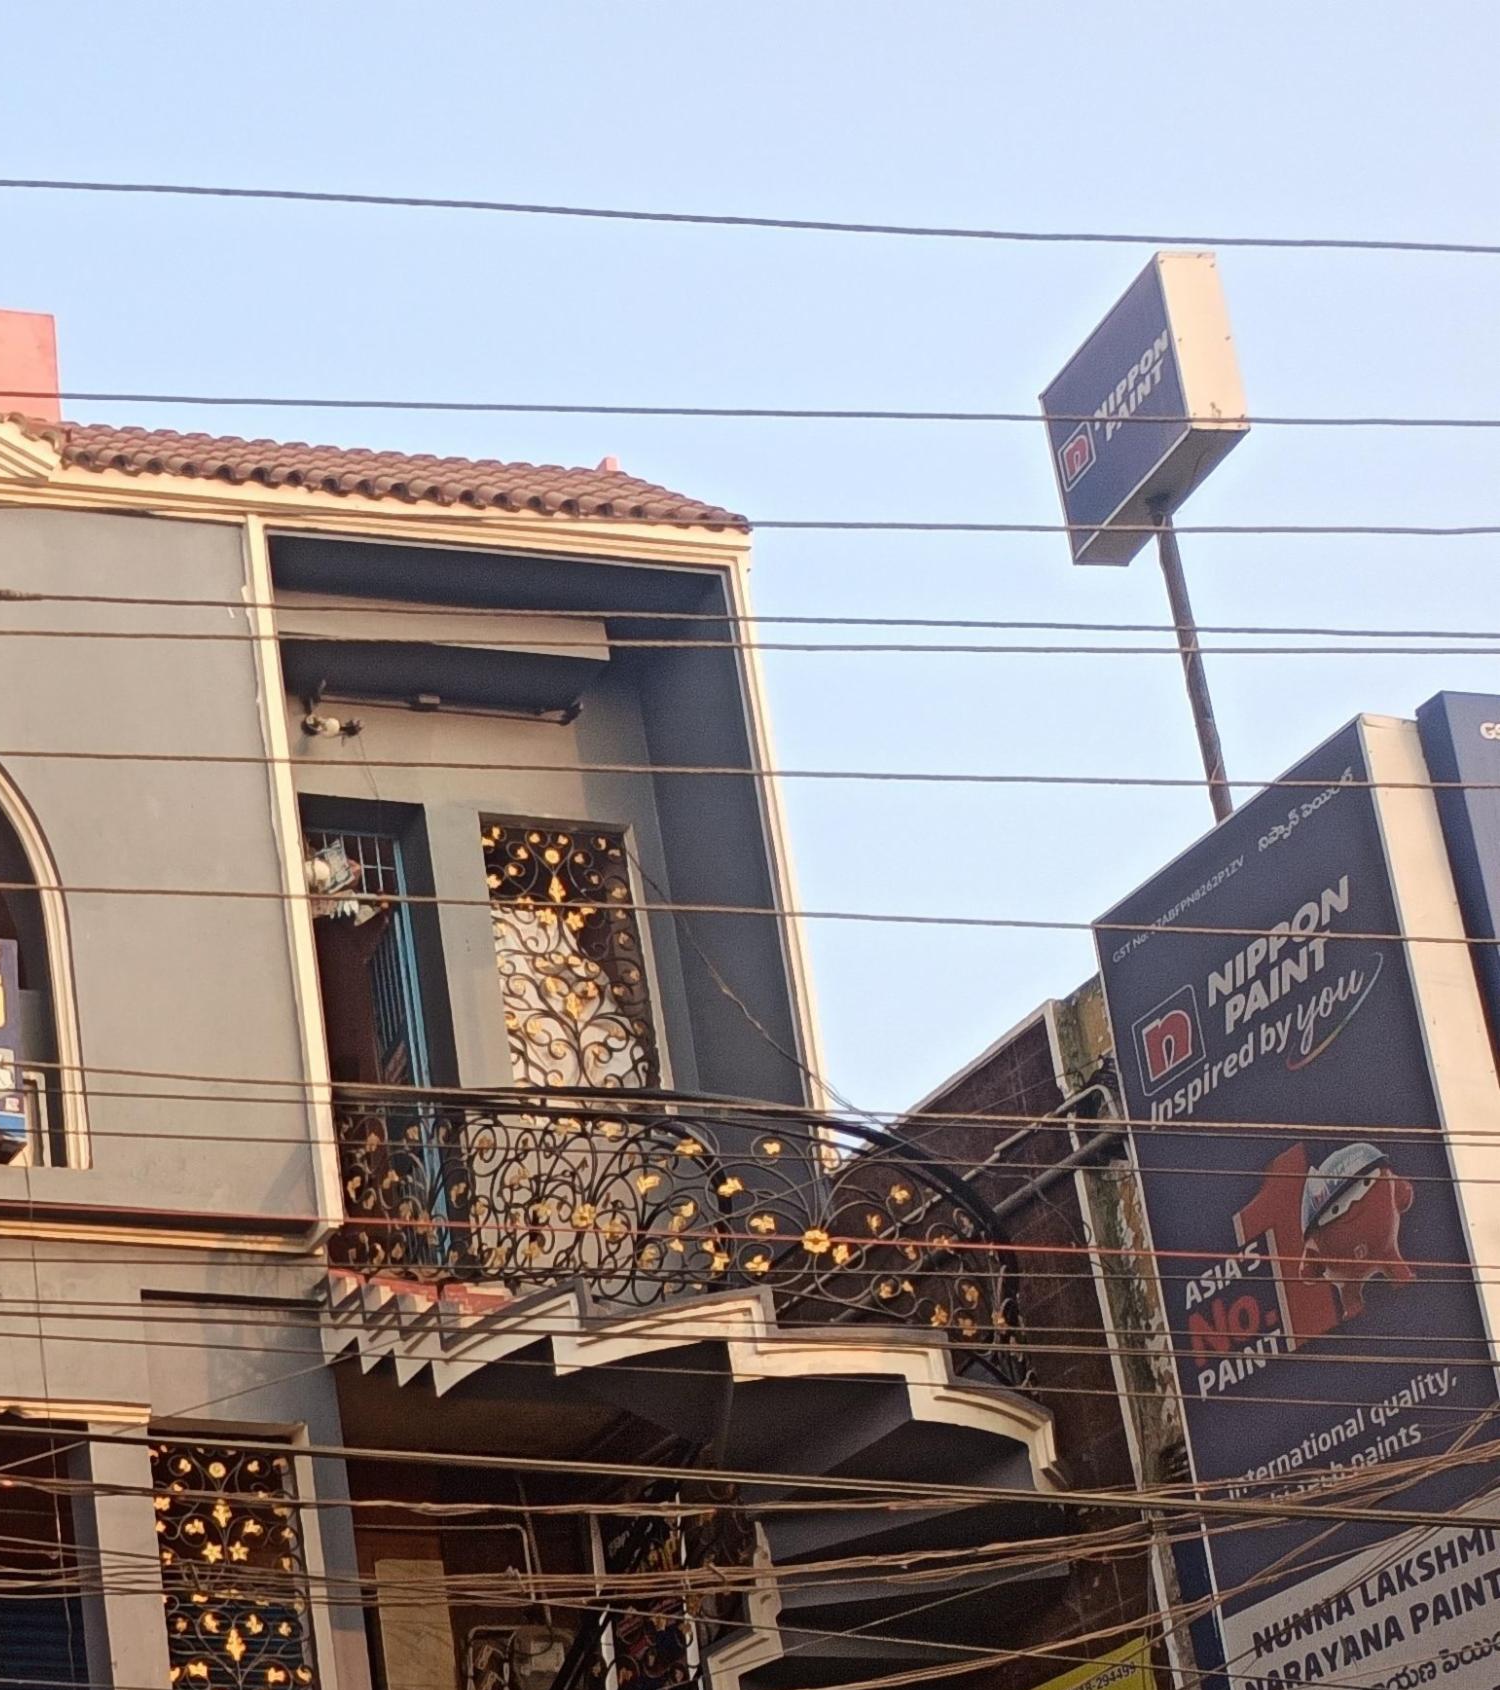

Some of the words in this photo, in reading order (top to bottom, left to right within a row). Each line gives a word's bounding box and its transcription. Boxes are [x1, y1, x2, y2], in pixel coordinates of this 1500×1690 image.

[1208, 875, 1349, 1007] NIPPON
[1225, 929, 1331, 1035] PAINT
[1151, 1031, 1254, 1131] Inspired
[1260, 1013, 1292, 1055] by
[1298, 968, 1365, 1056] you
[1252, 1594, 1357, 1657] NUNNA
